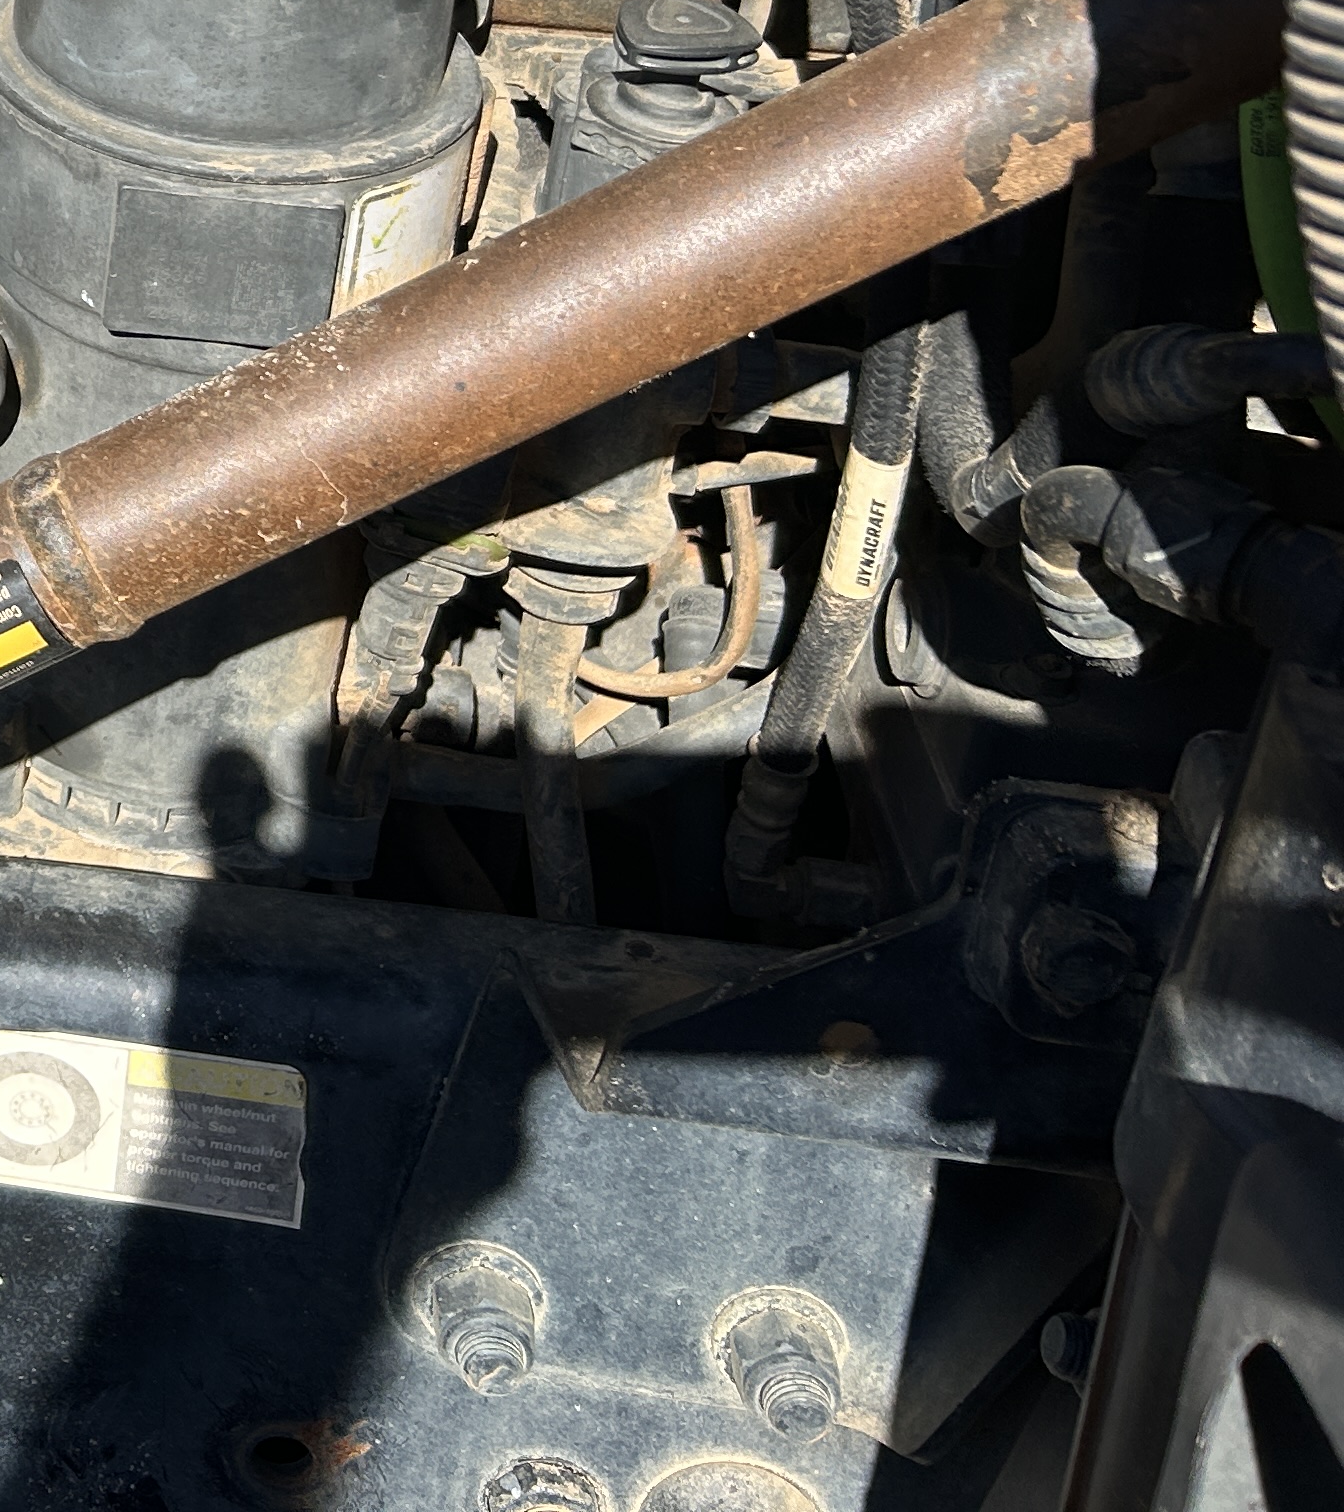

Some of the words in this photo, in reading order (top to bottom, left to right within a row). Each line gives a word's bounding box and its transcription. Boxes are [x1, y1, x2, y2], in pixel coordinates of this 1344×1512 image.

[855, 498, 887, 588] DYNACRAFT
[201, 1104, 277, 1123] wheel/nut
[208, 1121, 237, 1135] See
[126, 1144, 178, 1161] proper
[181, 1152, 230, 1169] torque
[233, 1160, 263, 1174] and
[209, 1139, 264, 1155] manual
[268, 1147, 291, 1160] for
[125, 1159, 200, 1184] tightening
[204, 1174, 281, 1193] sequence.
